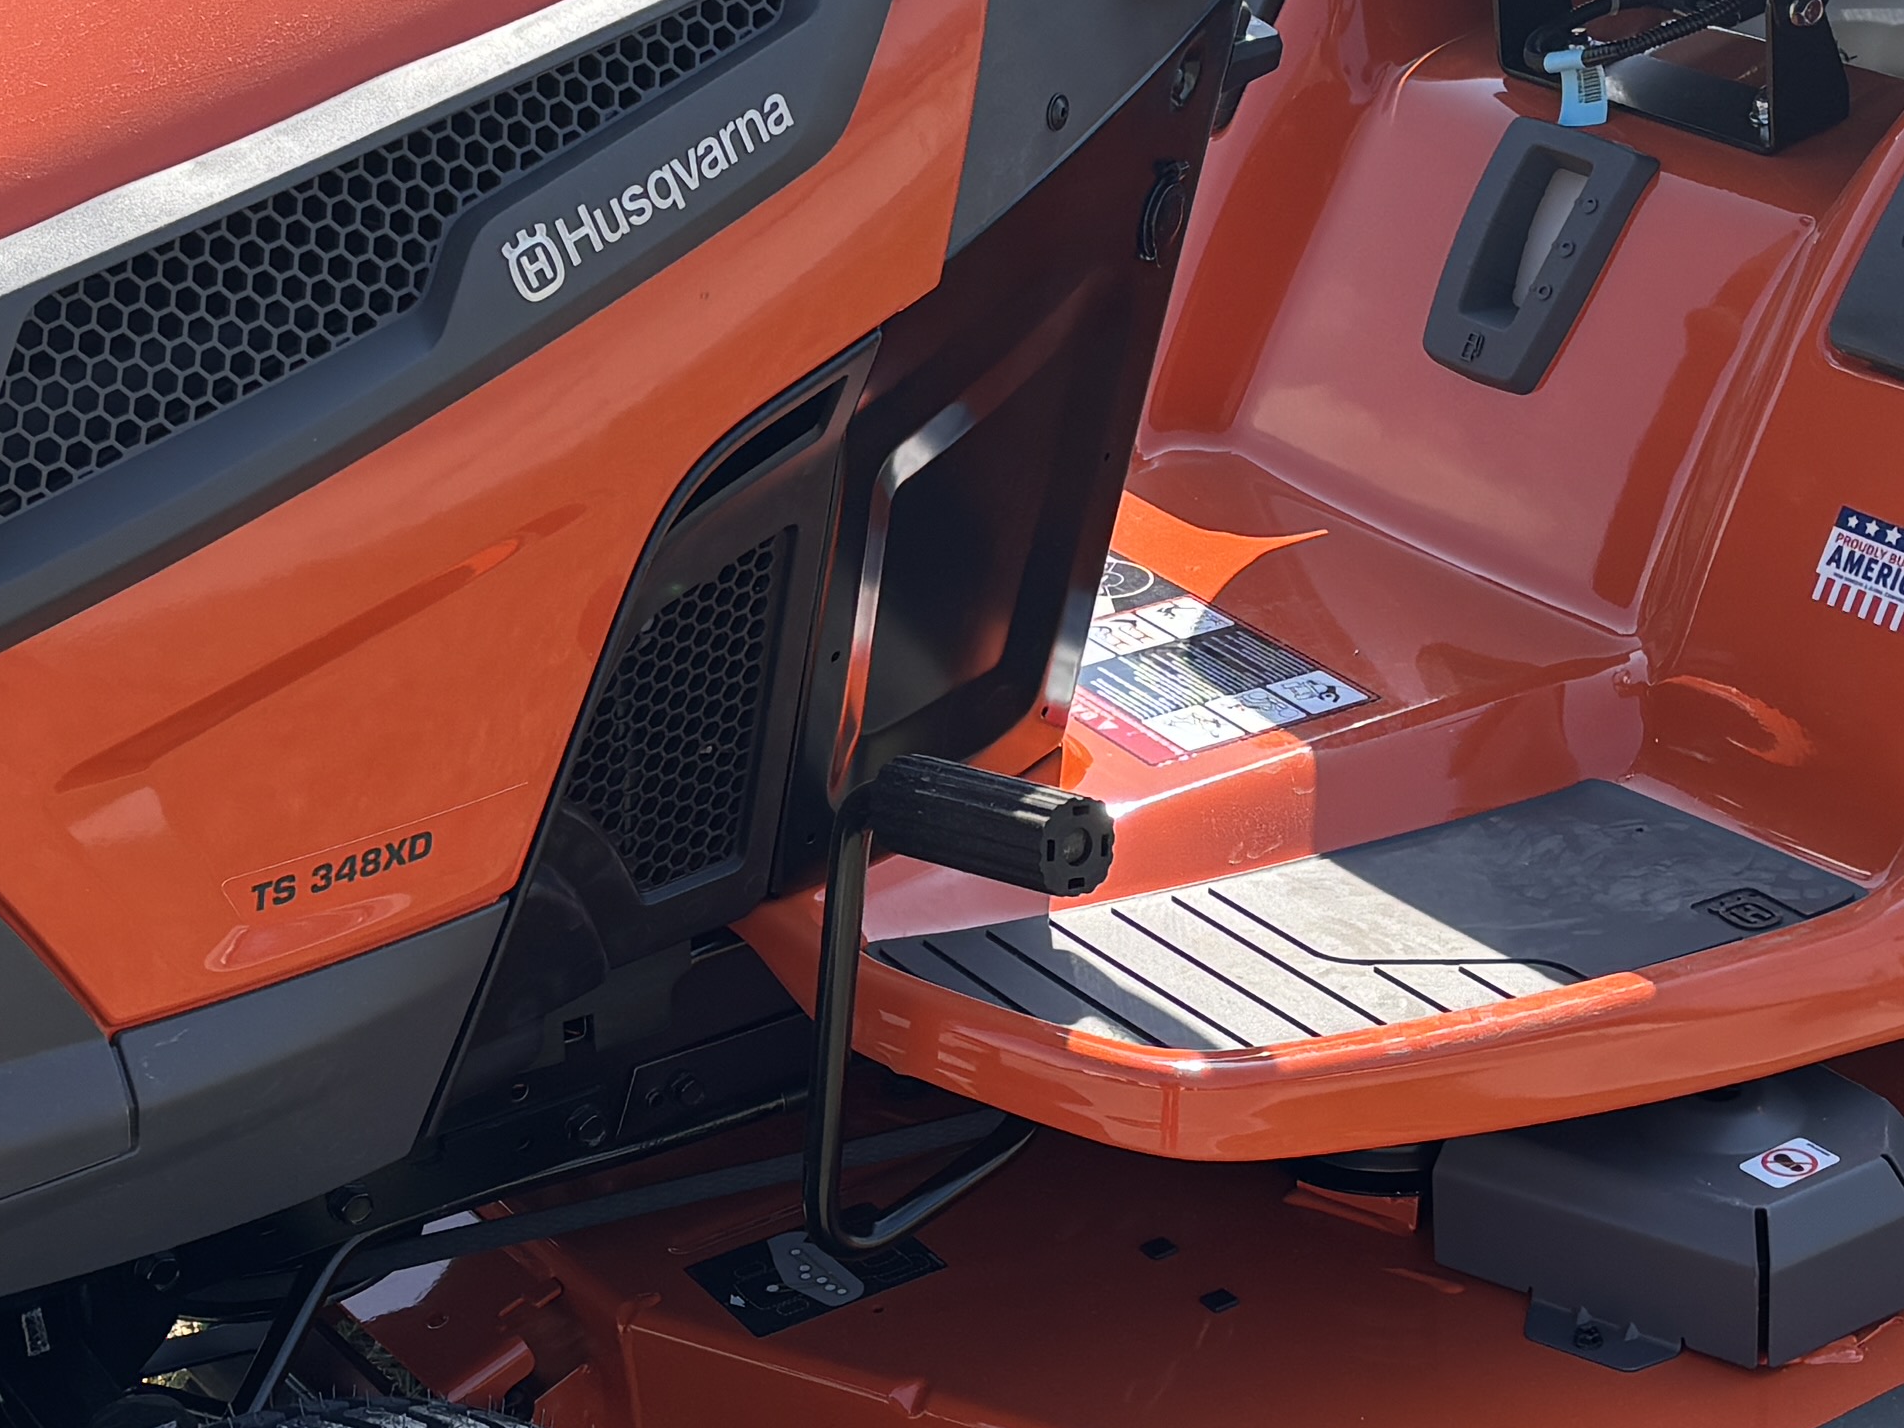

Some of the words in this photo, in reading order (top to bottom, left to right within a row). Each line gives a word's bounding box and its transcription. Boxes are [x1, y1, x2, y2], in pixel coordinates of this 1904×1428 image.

[554, 92, 795, 267] Husqvarna
[1835, 532, 1889, 560] PROUDLY
[251, 874, 297, 912] TS
[310, 830, 433, 894] 348XD
